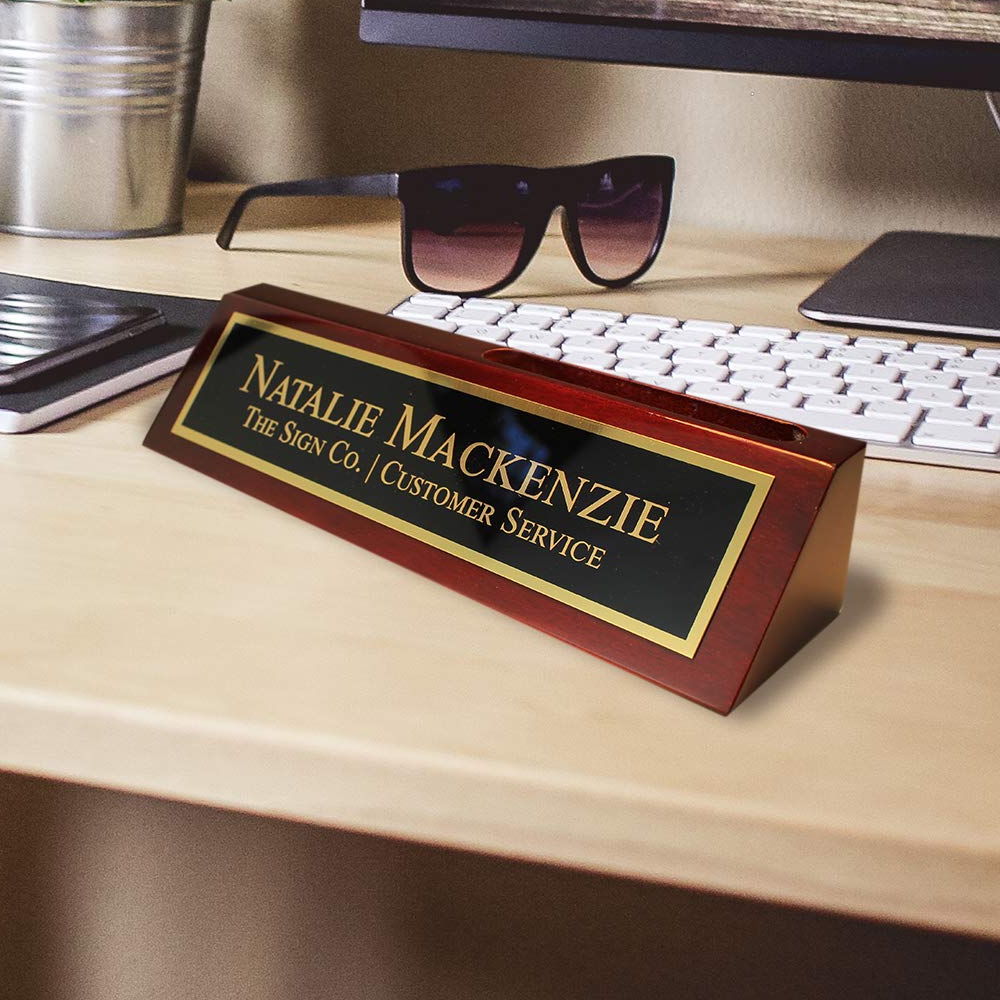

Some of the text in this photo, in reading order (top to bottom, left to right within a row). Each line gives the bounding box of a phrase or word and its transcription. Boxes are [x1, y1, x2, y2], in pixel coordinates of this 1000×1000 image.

[239, 353, 384, 438] NATALIE
[242, 405, 279, 438] THE
[278, 420, 327, 456] SIGN
[380, 460, 496, 526] CUSTOMER
[500, 506, 607, 569] SERVICE
